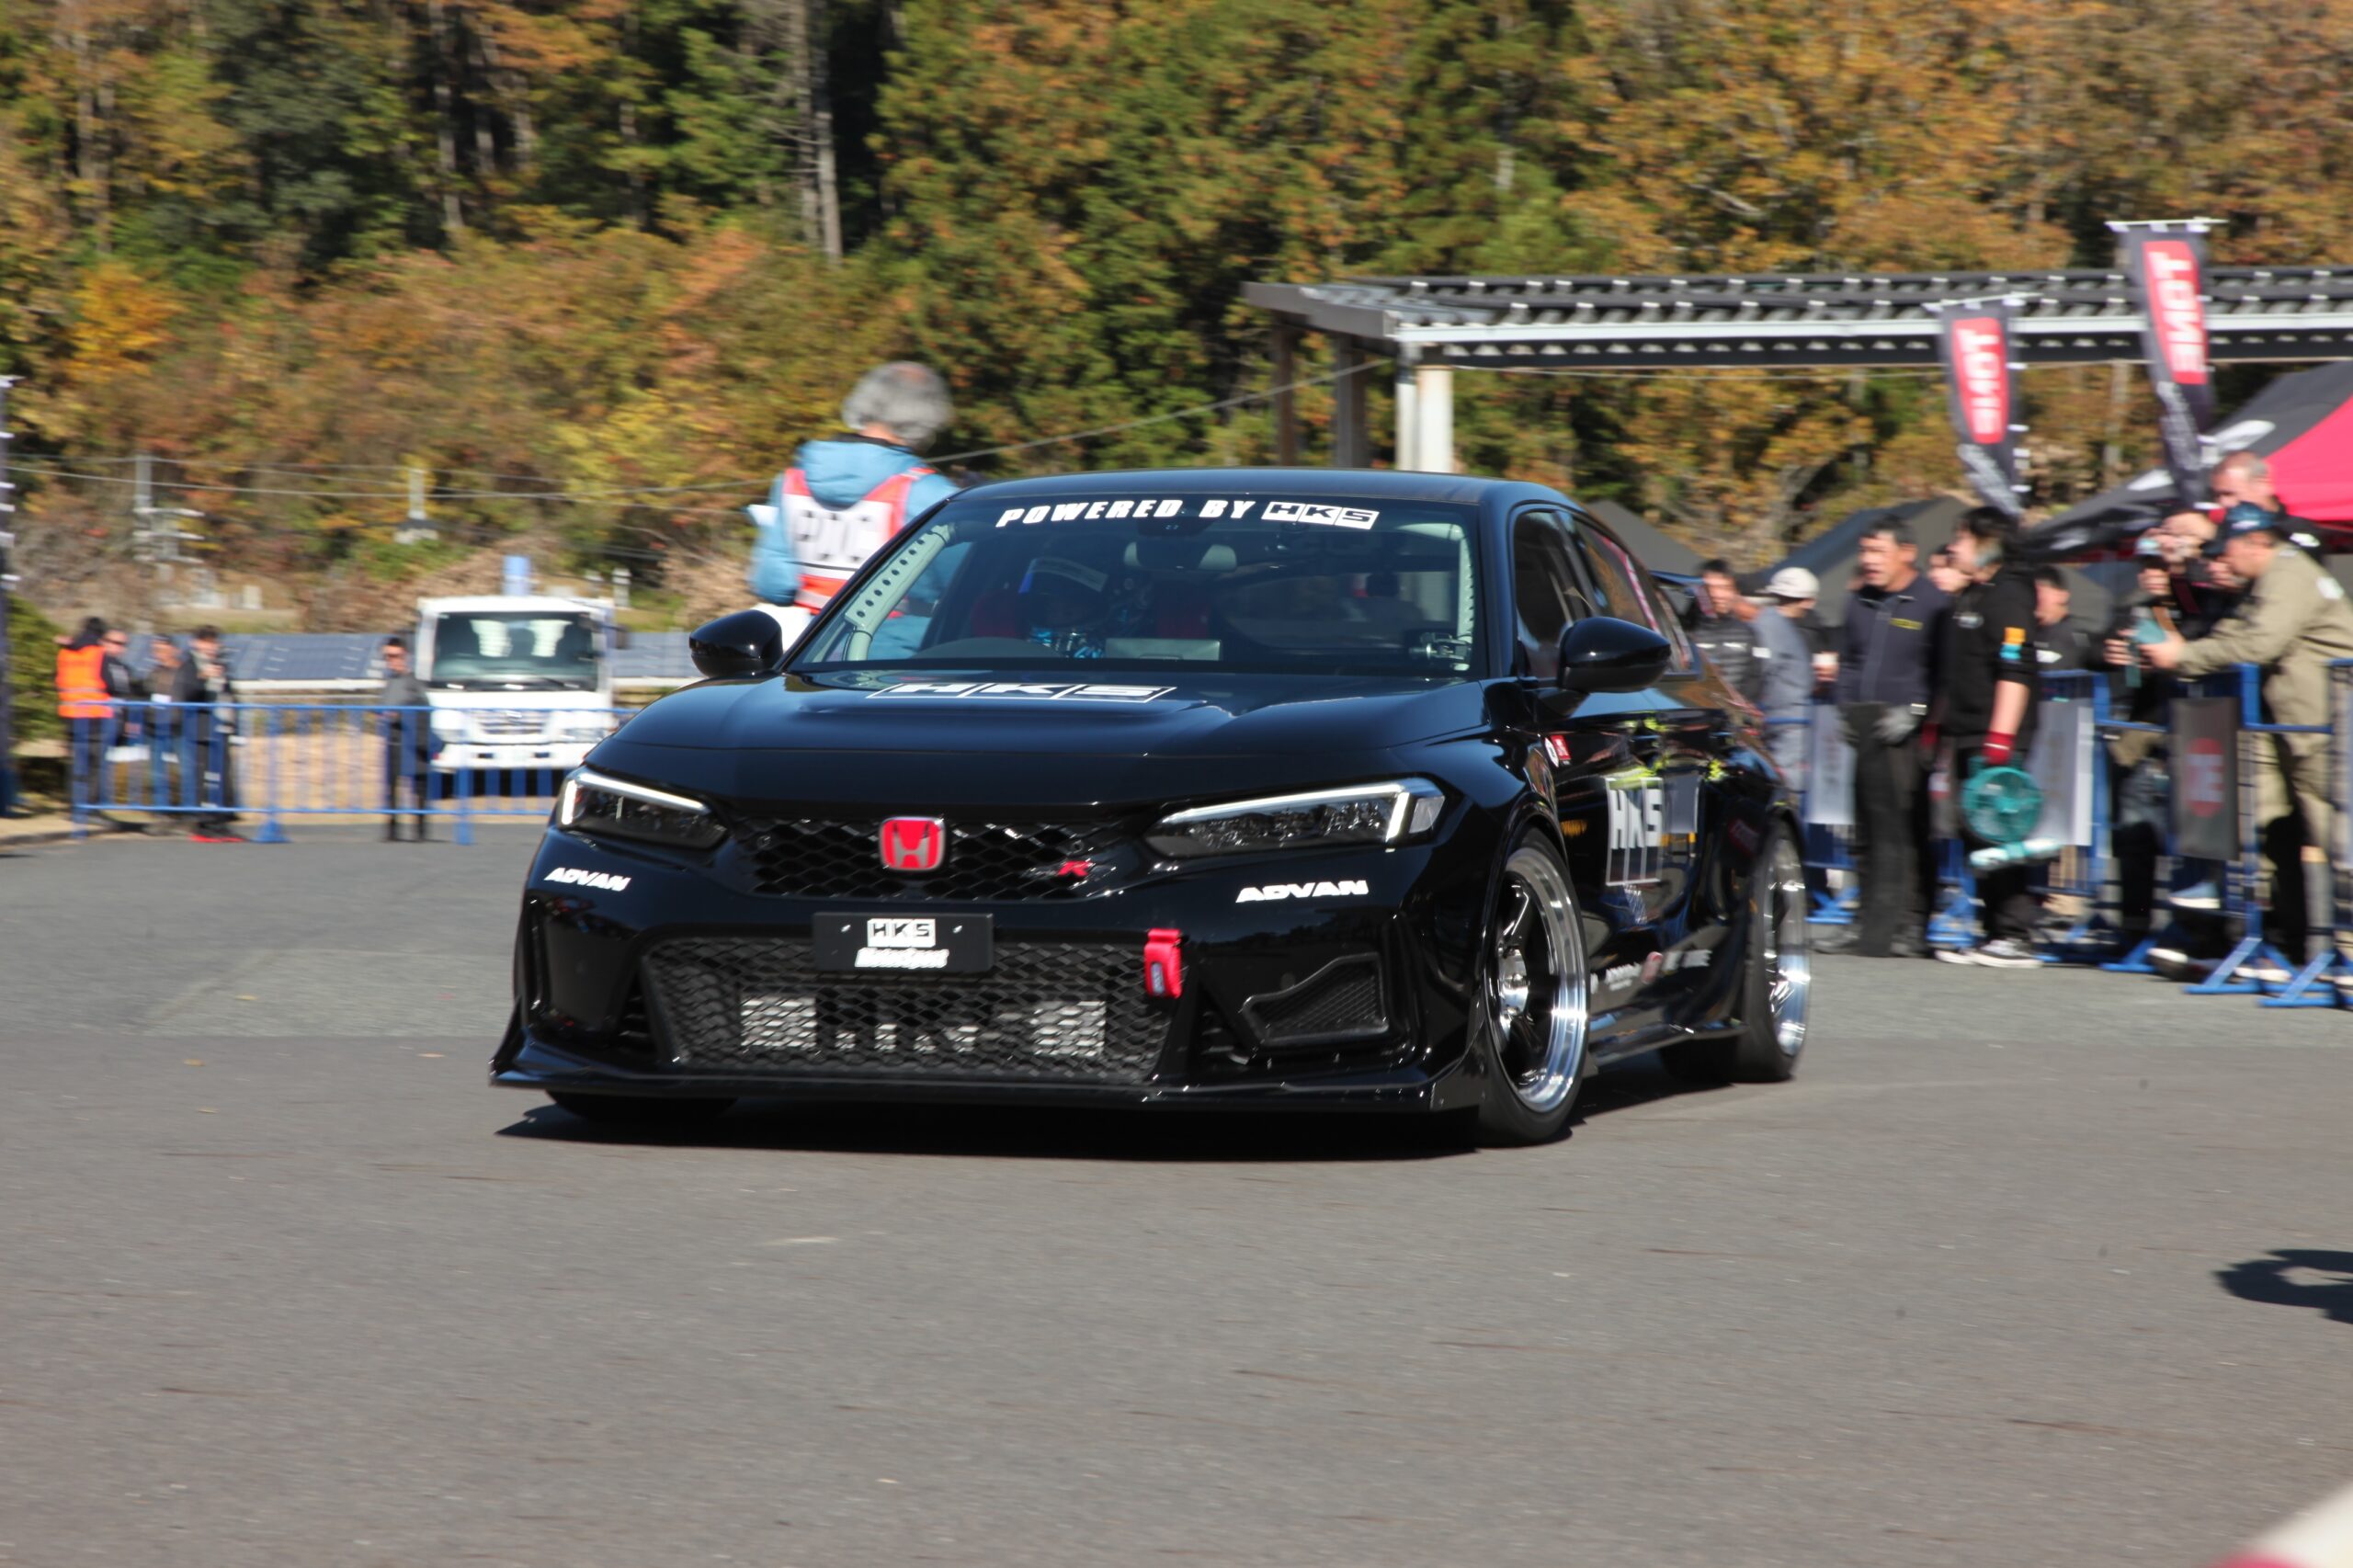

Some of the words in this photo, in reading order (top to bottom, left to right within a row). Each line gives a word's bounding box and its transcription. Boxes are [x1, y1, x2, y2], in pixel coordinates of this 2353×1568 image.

[995, 499, 1192, 528] POWERED
[1199, 500, 1256, 518] BY
[1265, 502, 1377, 527] HKS
[878, 683, 1171, 699] HKS
[543, 867, 632, 892] ADVAN
[1235, 880, 1369, 903] ADVAN
[870, 920, 932, 942] HKS
